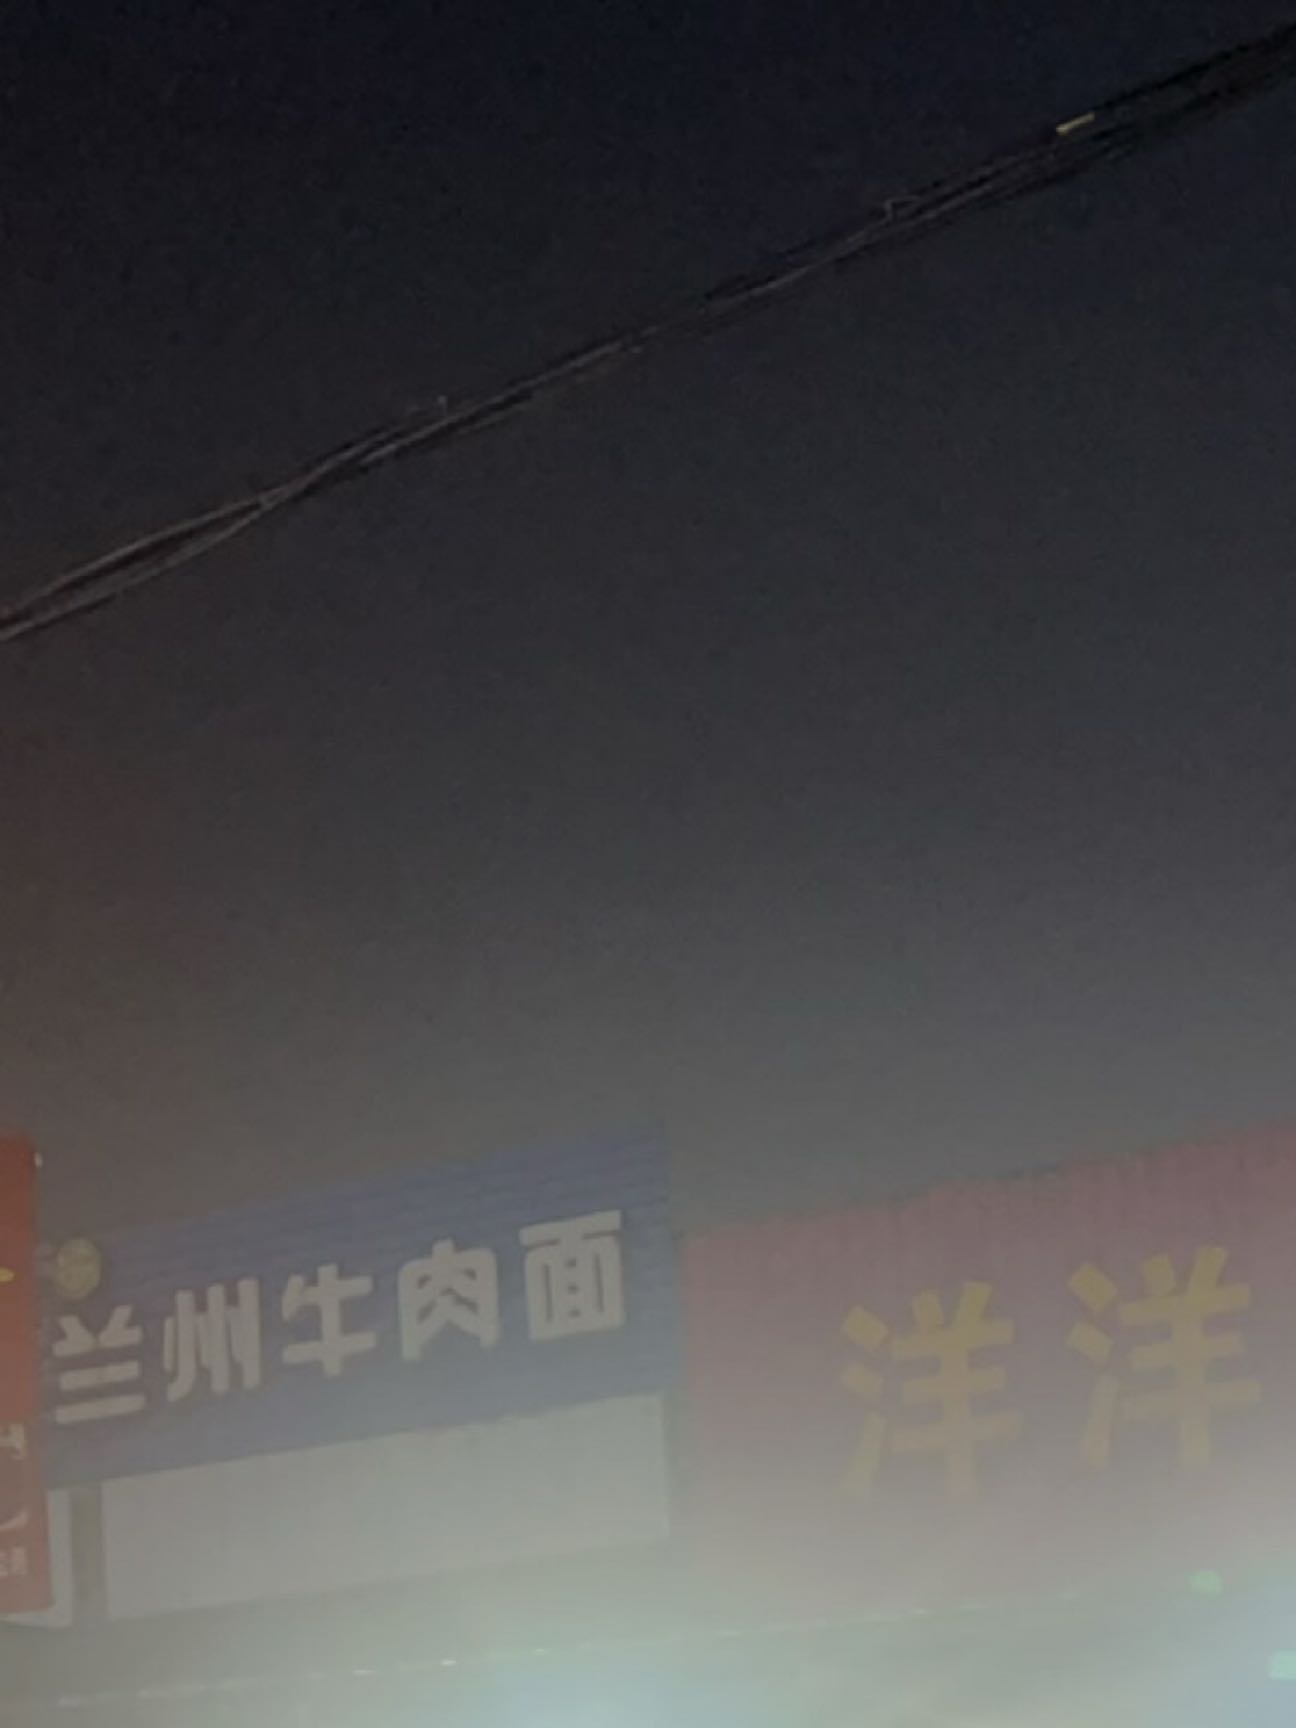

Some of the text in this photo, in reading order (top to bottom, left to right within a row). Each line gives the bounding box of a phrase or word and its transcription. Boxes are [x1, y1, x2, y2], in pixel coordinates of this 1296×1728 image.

[53, 1210, 626, 1424] 兰州牛肉面
